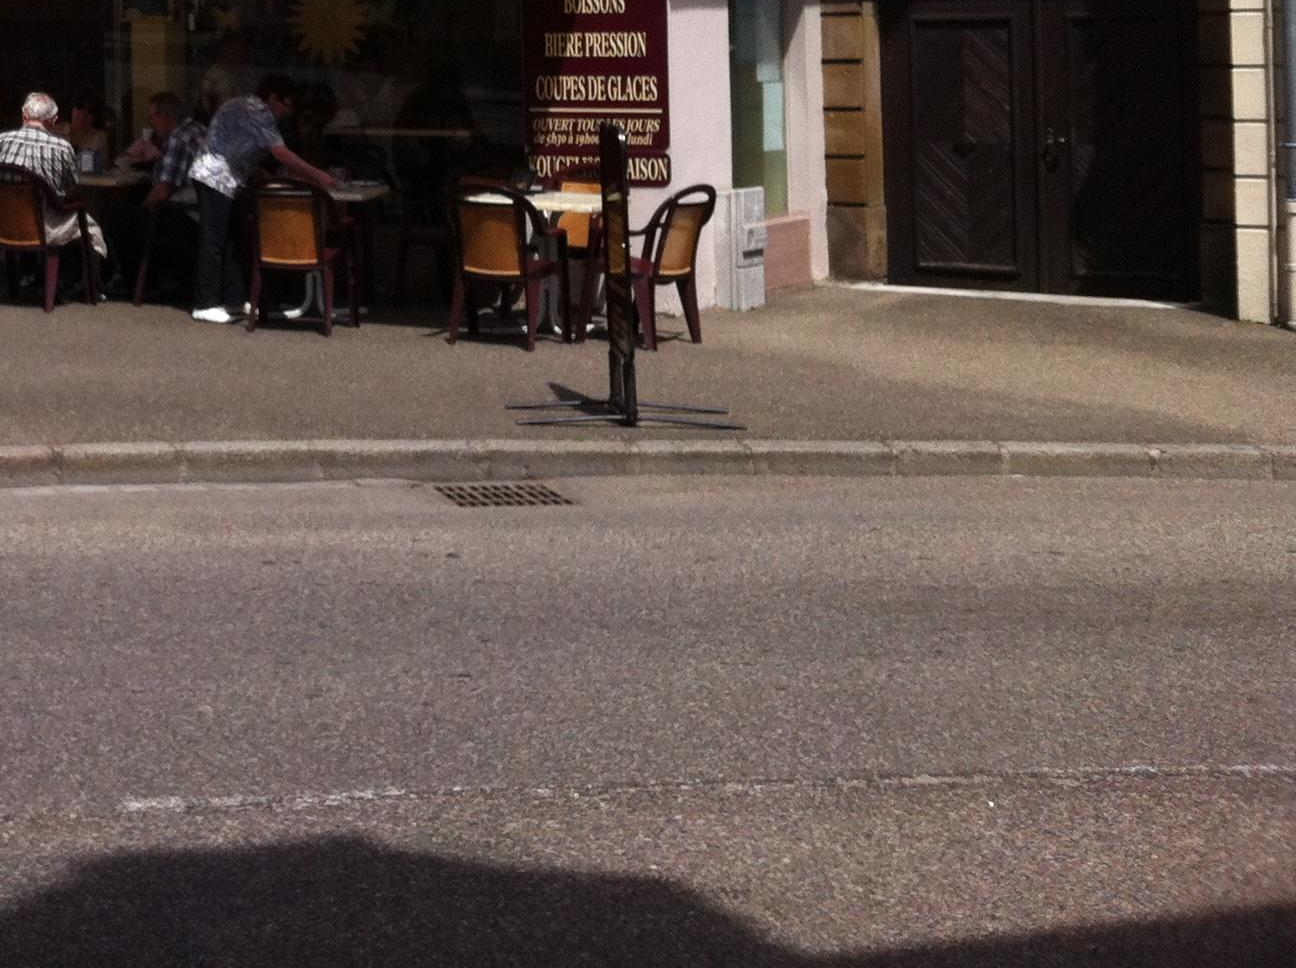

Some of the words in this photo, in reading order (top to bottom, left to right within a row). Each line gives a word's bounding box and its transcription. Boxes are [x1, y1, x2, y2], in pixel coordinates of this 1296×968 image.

[545, 32, 584, 58] BIERE
[586, 32, 647, 58] PRESSION
[536, 76, 586, 101] COUPES
[588, 76, 607, 101] DE
[608, 76, 658, 102] GLACES
[533, 118, 577, 132] OUVERT
[625, 119, 661, 134] JOURS
[626, 158, 668, 181] AISON
